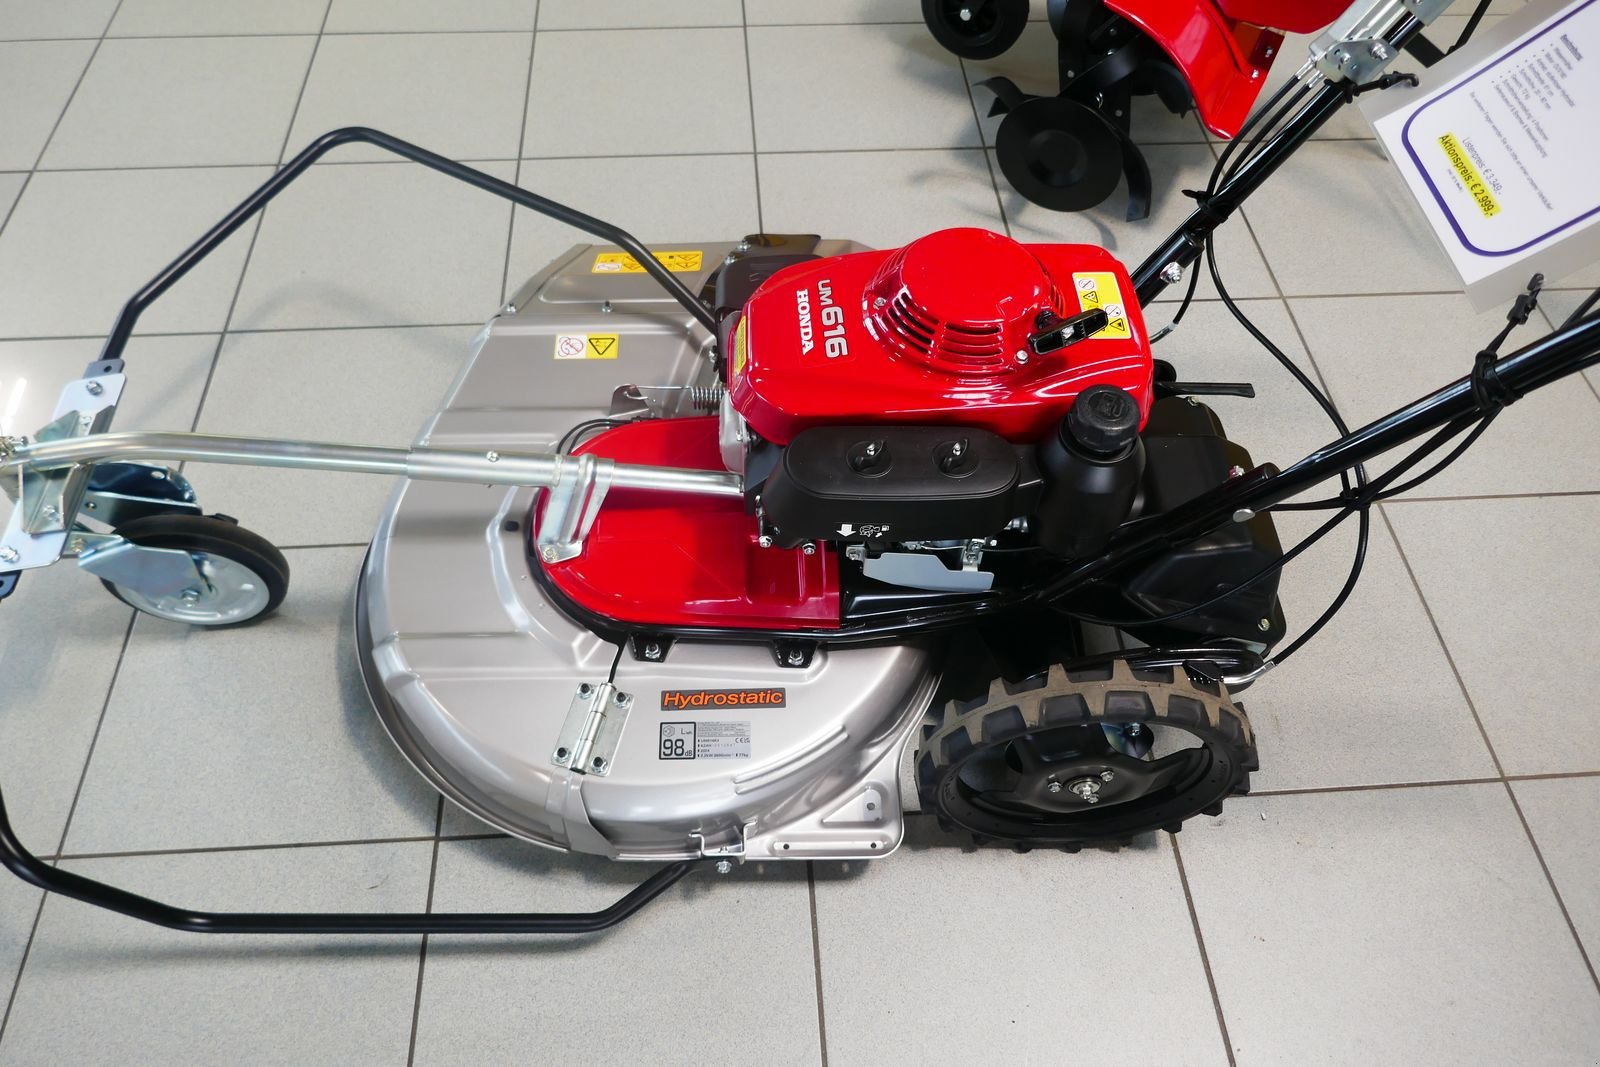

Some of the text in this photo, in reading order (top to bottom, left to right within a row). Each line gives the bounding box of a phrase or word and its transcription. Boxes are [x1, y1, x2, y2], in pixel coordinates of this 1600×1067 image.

[1438, 134, 1475, 184] Aktionspreis:
[1462, 137, 1486, 168] Listenpreis:
[1470, 183, 1481, 191] €
[1474, 189, 1495, 217] 2.999,-
[796, 288, 814, 356] HONDA
[663, 690, 783, 709] Hydrostatic
[663, 739, 685, 756] 98
